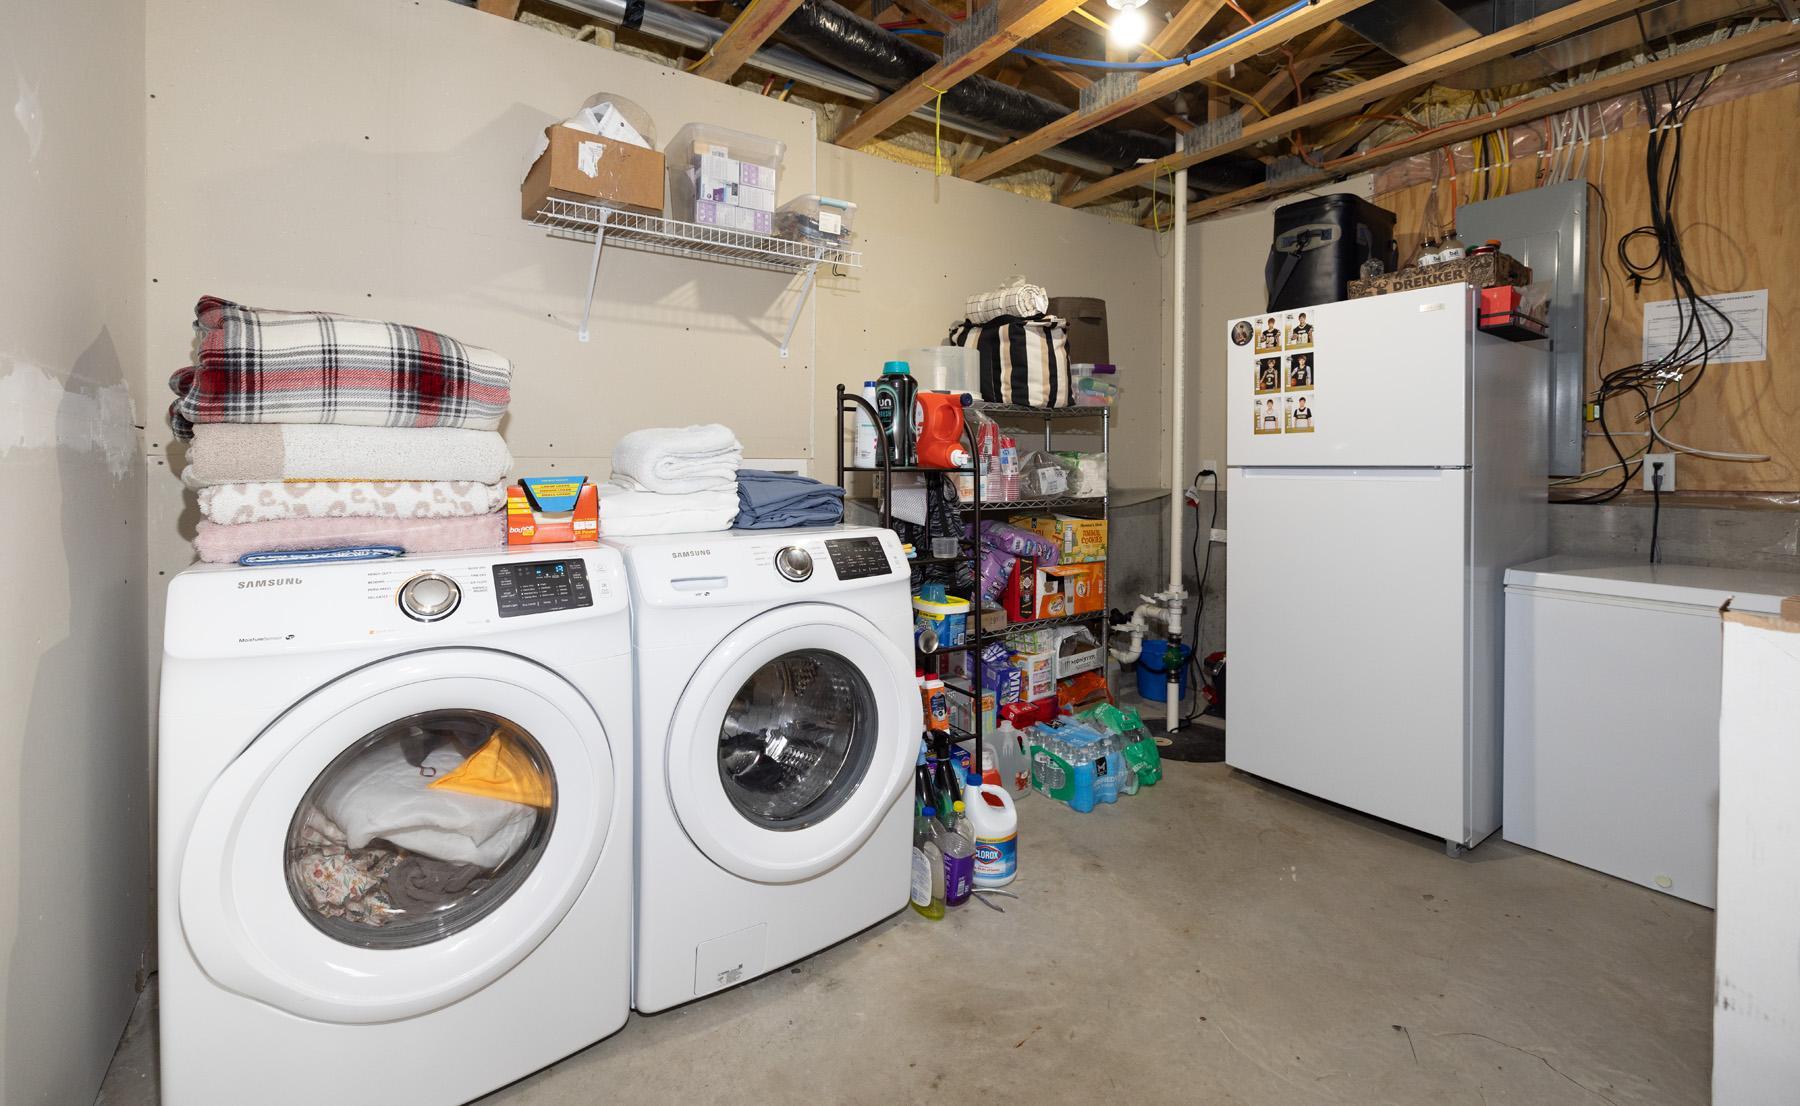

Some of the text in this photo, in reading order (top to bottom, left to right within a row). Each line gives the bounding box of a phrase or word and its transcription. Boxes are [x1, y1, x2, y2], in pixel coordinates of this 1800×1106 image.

[1393, 269, 1465, 291] DREKKER
[672, 549, 711, 559] SAMSUNG
[237, 577, 304, 589] SAMSUNG
